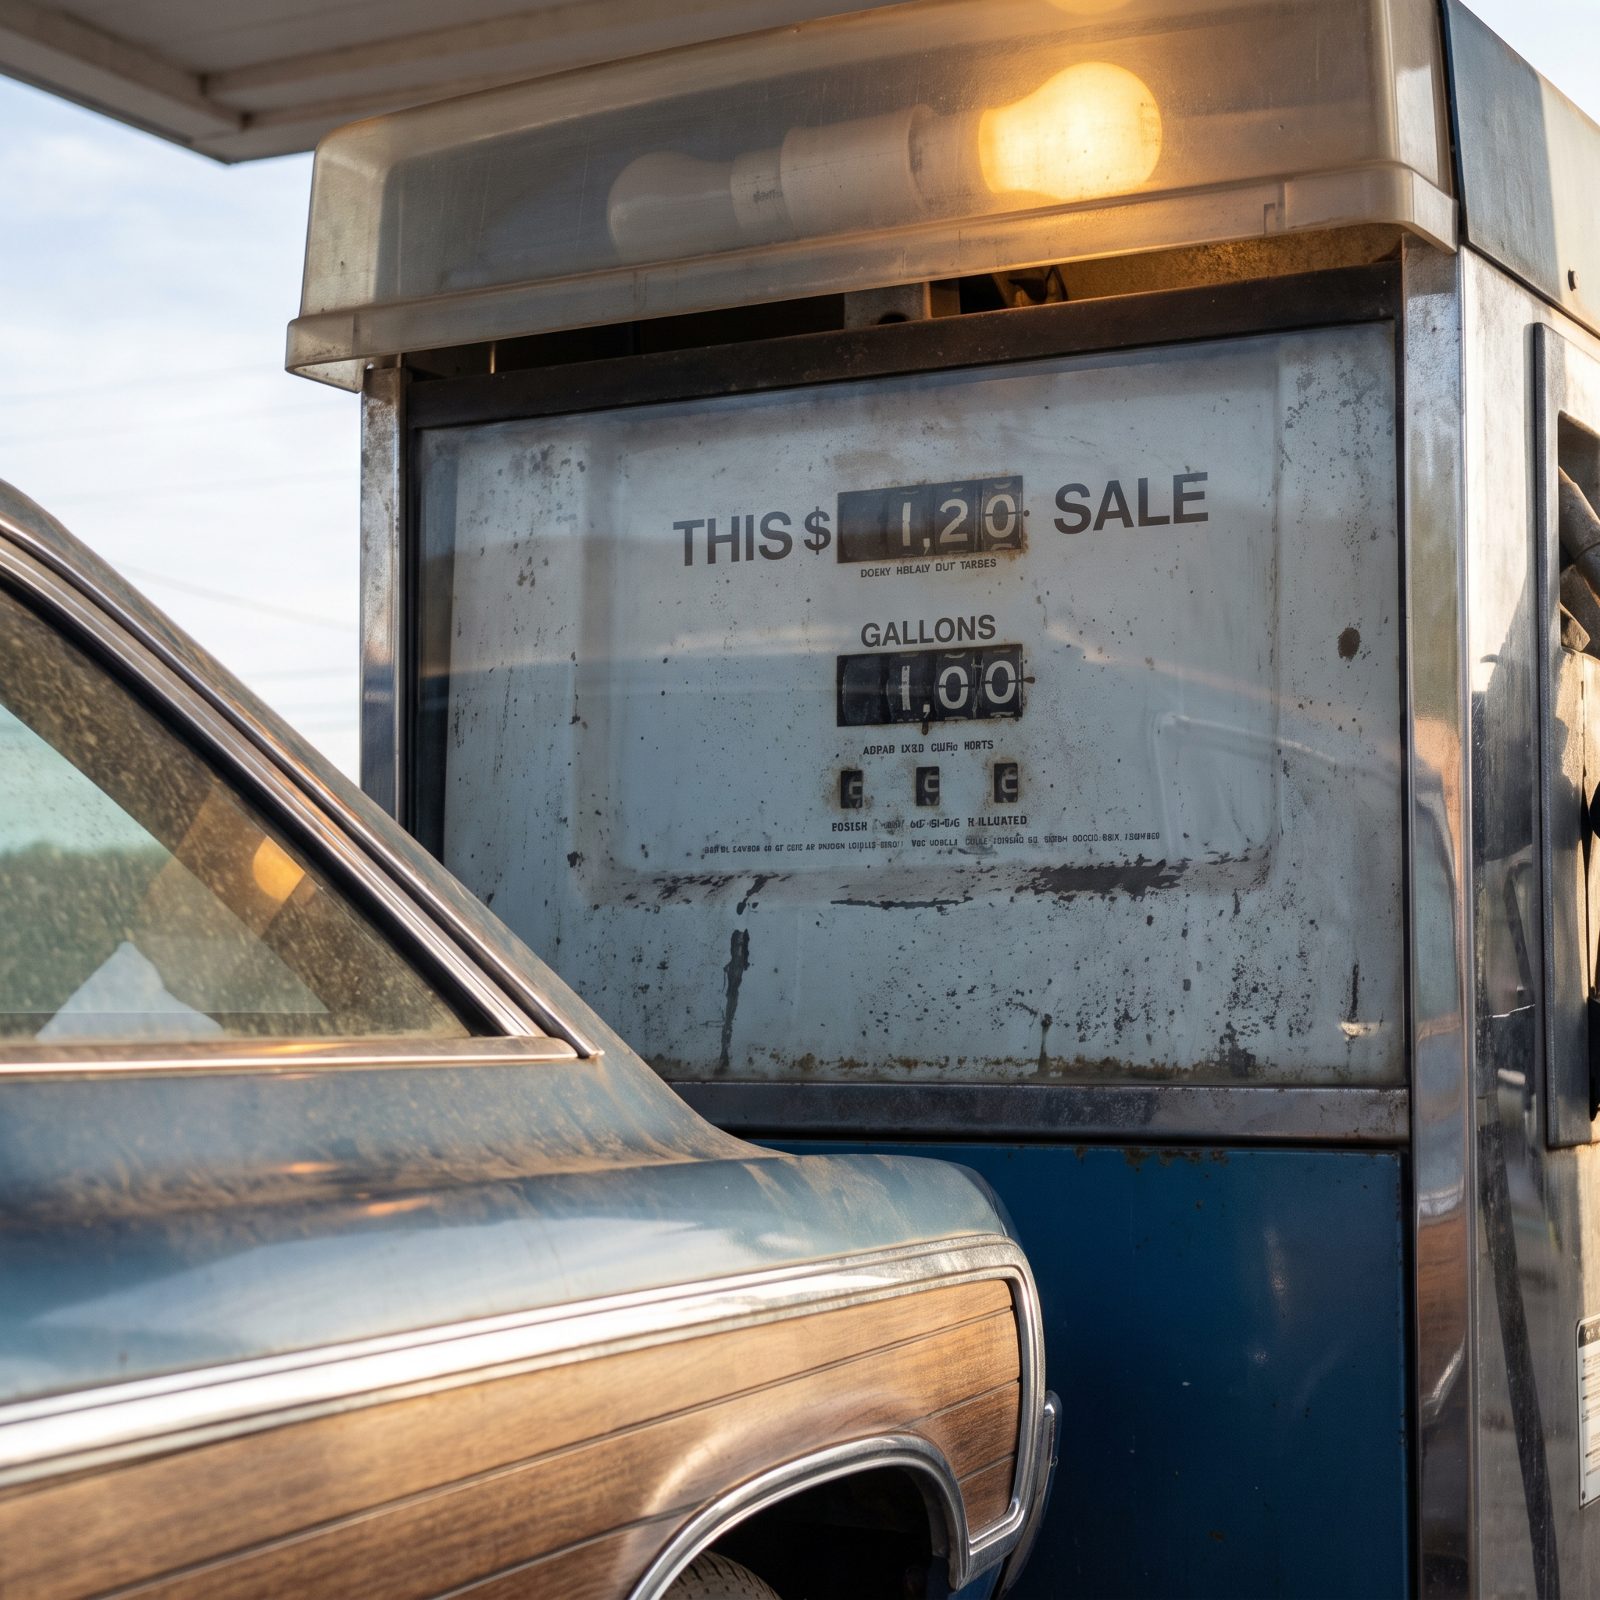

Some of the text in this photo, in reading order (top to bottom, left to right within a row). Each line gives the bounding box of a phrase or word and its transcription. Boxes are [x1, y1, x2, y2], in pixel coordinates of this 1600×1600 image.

[673, 511, 793, 567] THIS
[803, 506, 832, 555] $
[1053, 472, 1209, 535] SALE
[860, 614, 997, 648] GALLONS
